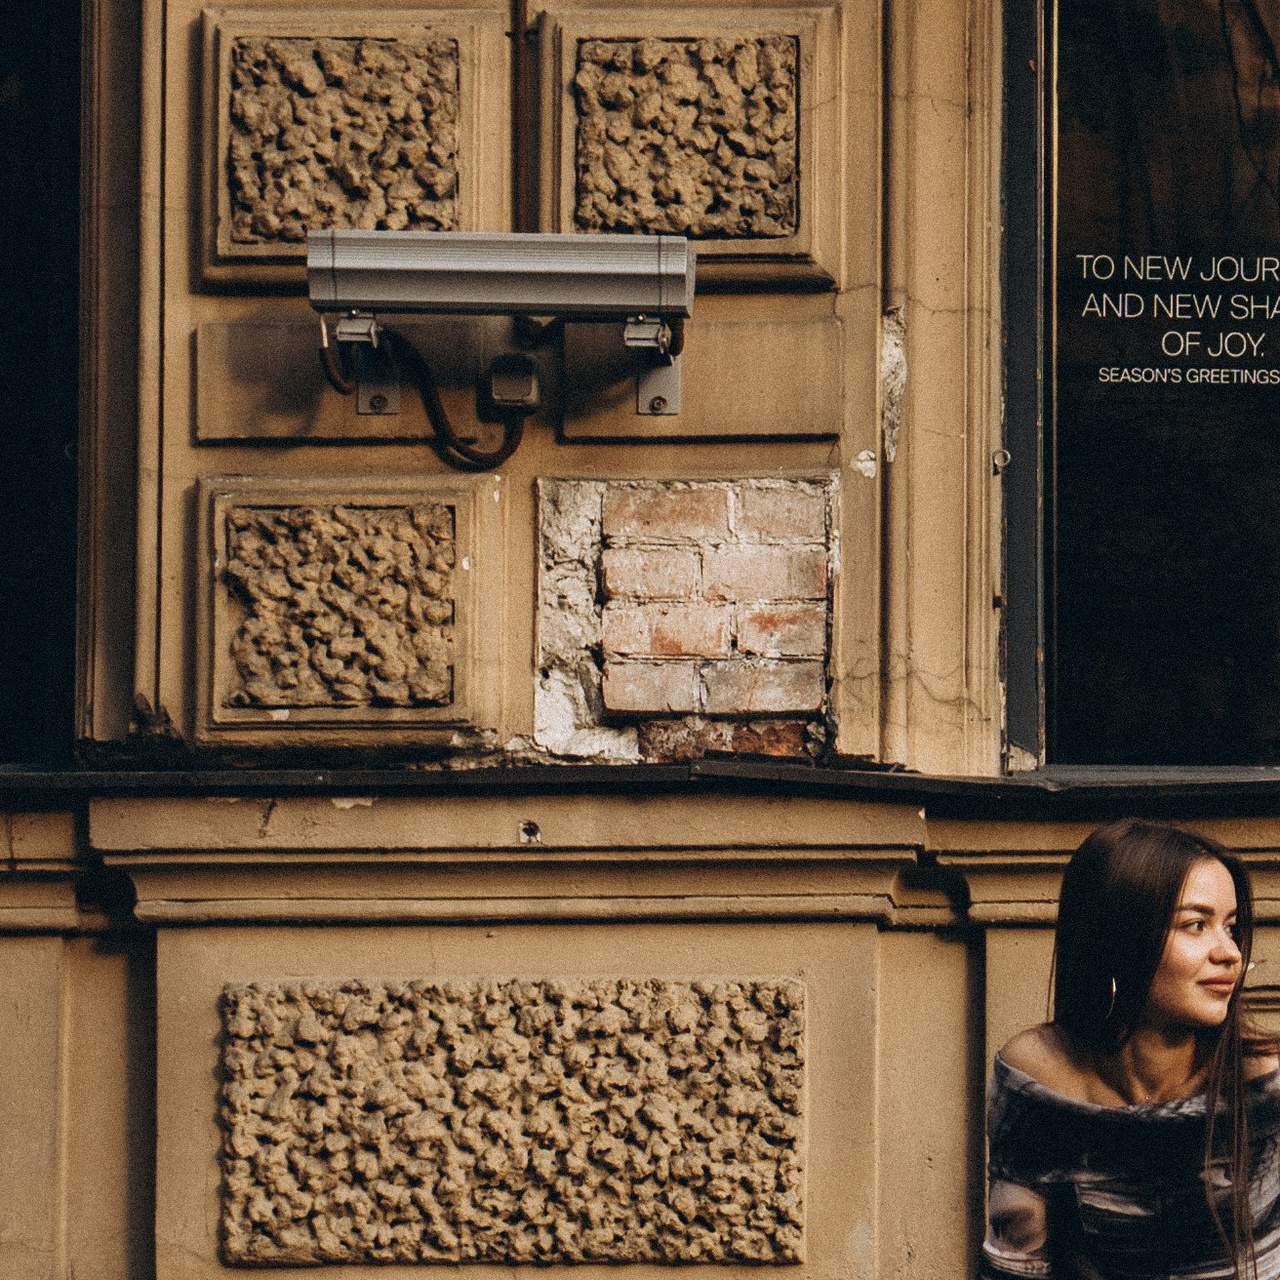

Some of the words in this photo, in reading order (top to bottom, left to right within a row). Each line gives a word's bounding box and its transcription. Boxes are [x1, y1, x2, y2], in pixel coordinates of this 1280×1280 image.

[1076, 254, 1115, 280] TO
[1124, 255, 1193, 280] NEW
[1081, 293, 1145, 318] AND
[1153, 293, 1222, 319] NEW
[1161, 330, 1201, 357] OF
[1207, 331, 1266, 358] JOY.
[1098, 367, 1182, 384] SEASON'S
[1185, 368, 1280, 385] GREETINGS
